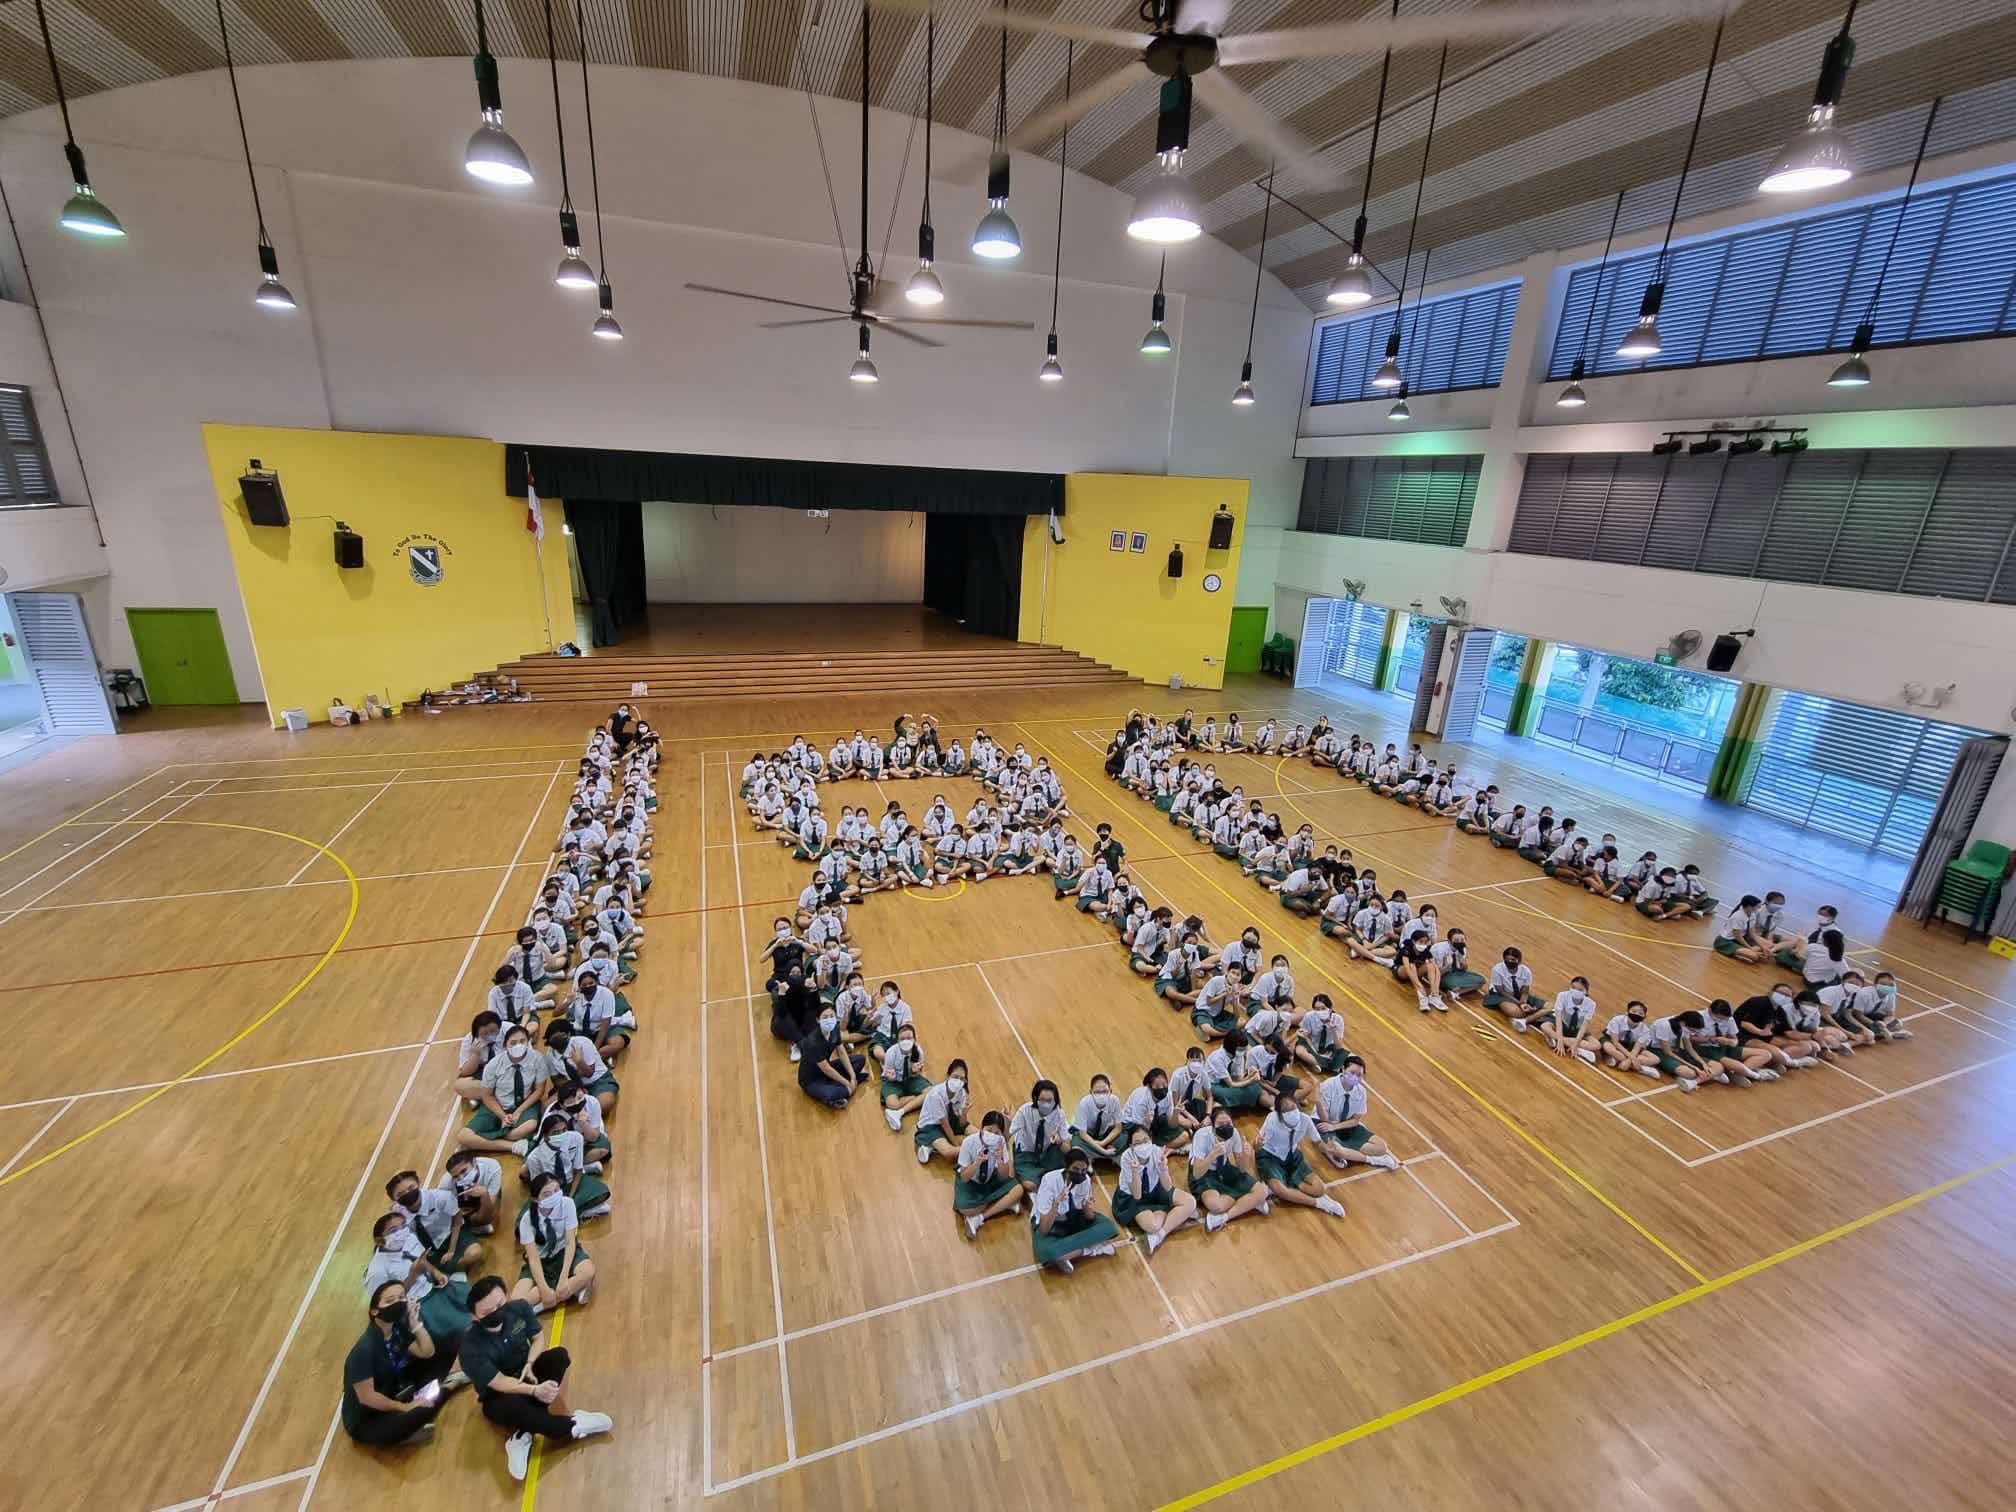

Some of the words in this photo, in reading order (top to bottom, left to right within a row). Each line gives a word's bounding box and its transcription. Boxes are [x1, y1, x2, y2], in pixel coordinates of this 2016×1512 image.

[397, 536, 410, 547] God
[423, 533, 436, 541] The
[438, 539, 452, 555] Glory
